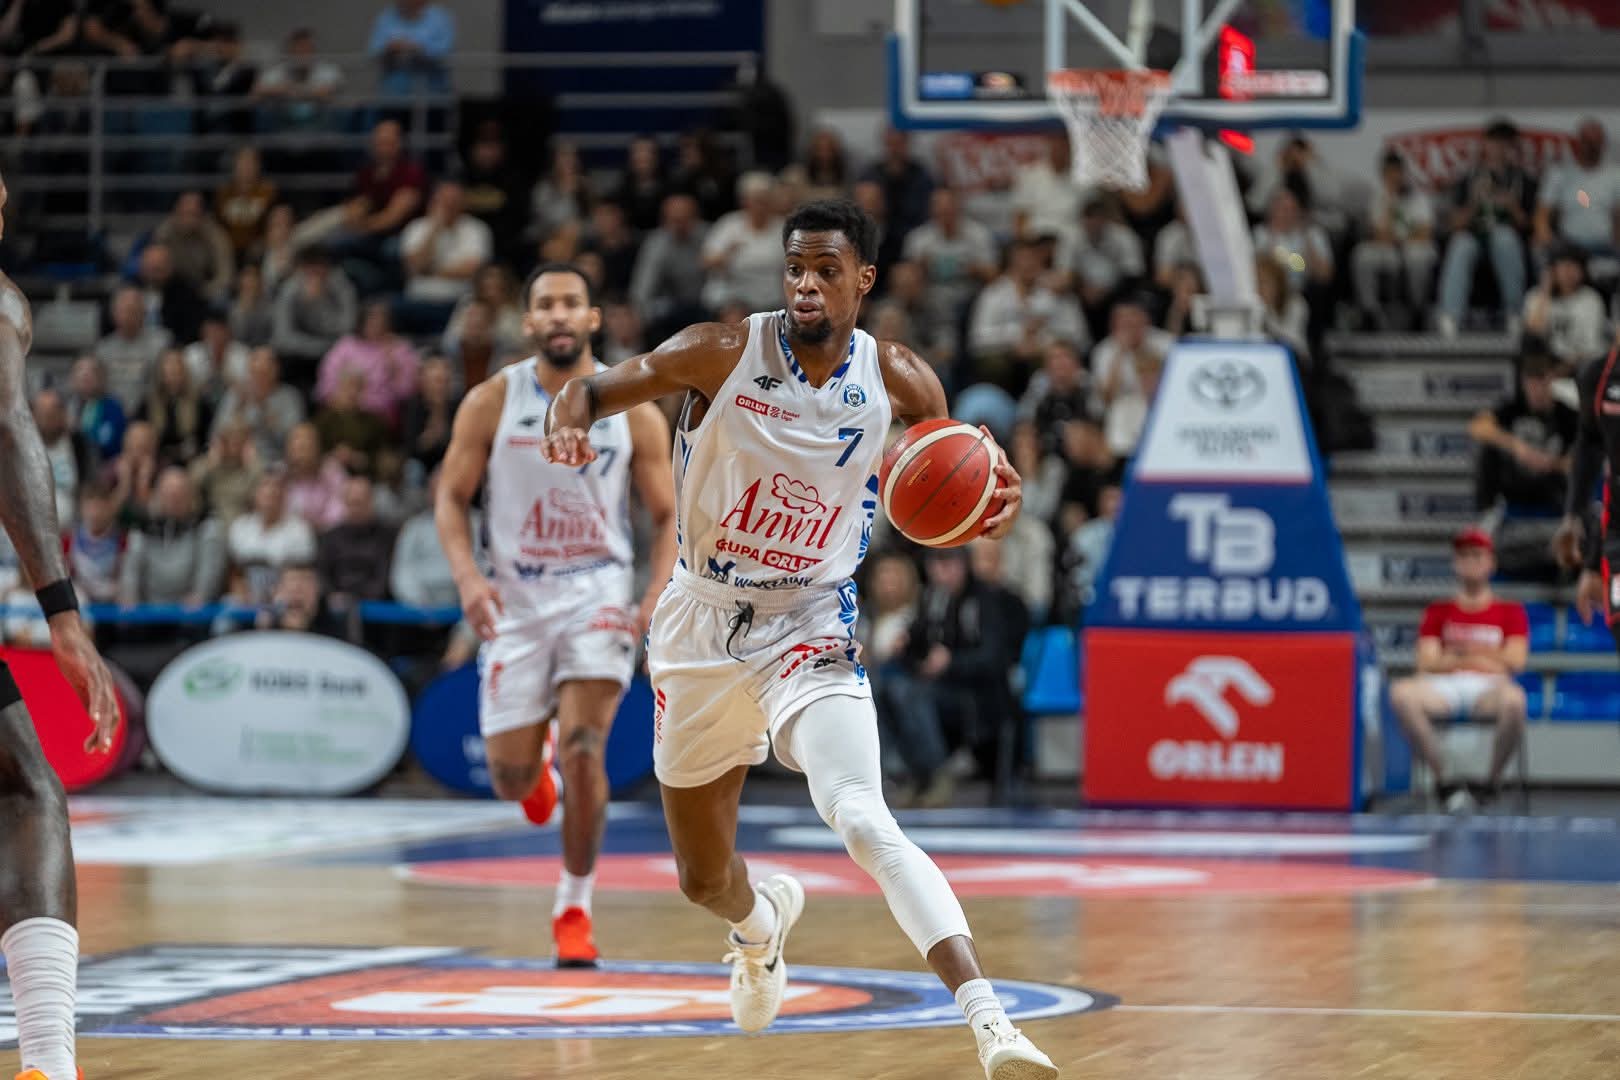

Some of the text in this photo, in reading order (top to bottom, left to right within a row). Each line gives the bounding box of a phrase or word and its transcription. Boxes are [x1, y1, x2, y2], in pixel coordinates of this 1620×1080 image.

[753, 375, 783, 391] 4F
[835, 427, 865, 467] 7
[719, 477, 842, 549] Anwil
[1110, 575, 1331, 621] TERBUD
[1148, 738, 1285, 783] ORLEN
